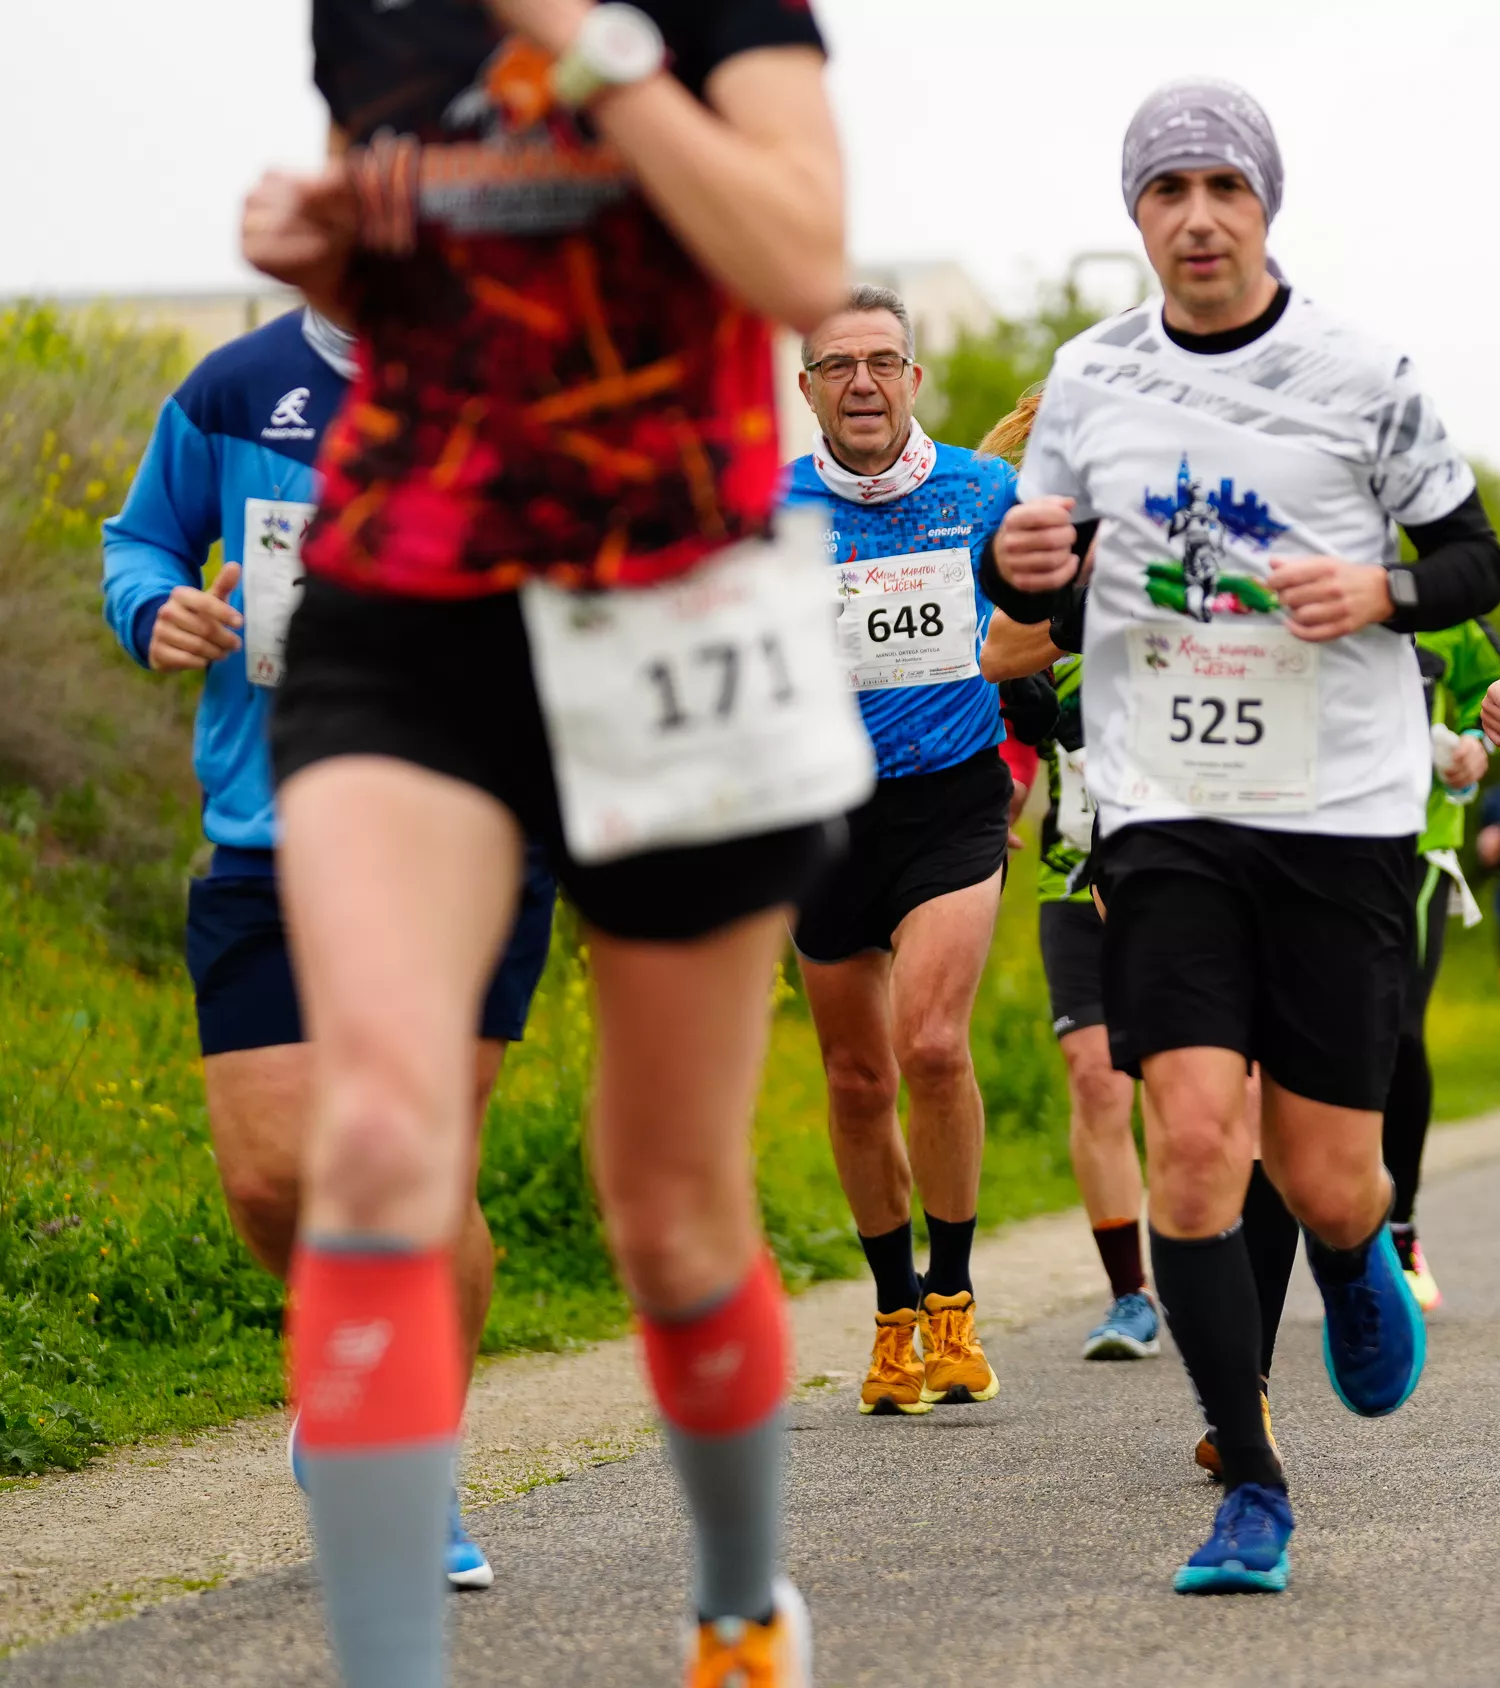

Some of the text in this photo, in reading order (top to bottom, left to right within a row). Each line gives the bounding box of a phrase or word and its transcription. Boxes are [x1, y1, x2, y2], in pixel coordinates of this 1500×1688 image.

[928, 525, 972, 537] enerplus
[883, 579, 929, 593] LUCENA
[867, 602, 944, 643] 648
[646, 636, 794, 730] 171
[1170, 695, 1265, 745] 525
